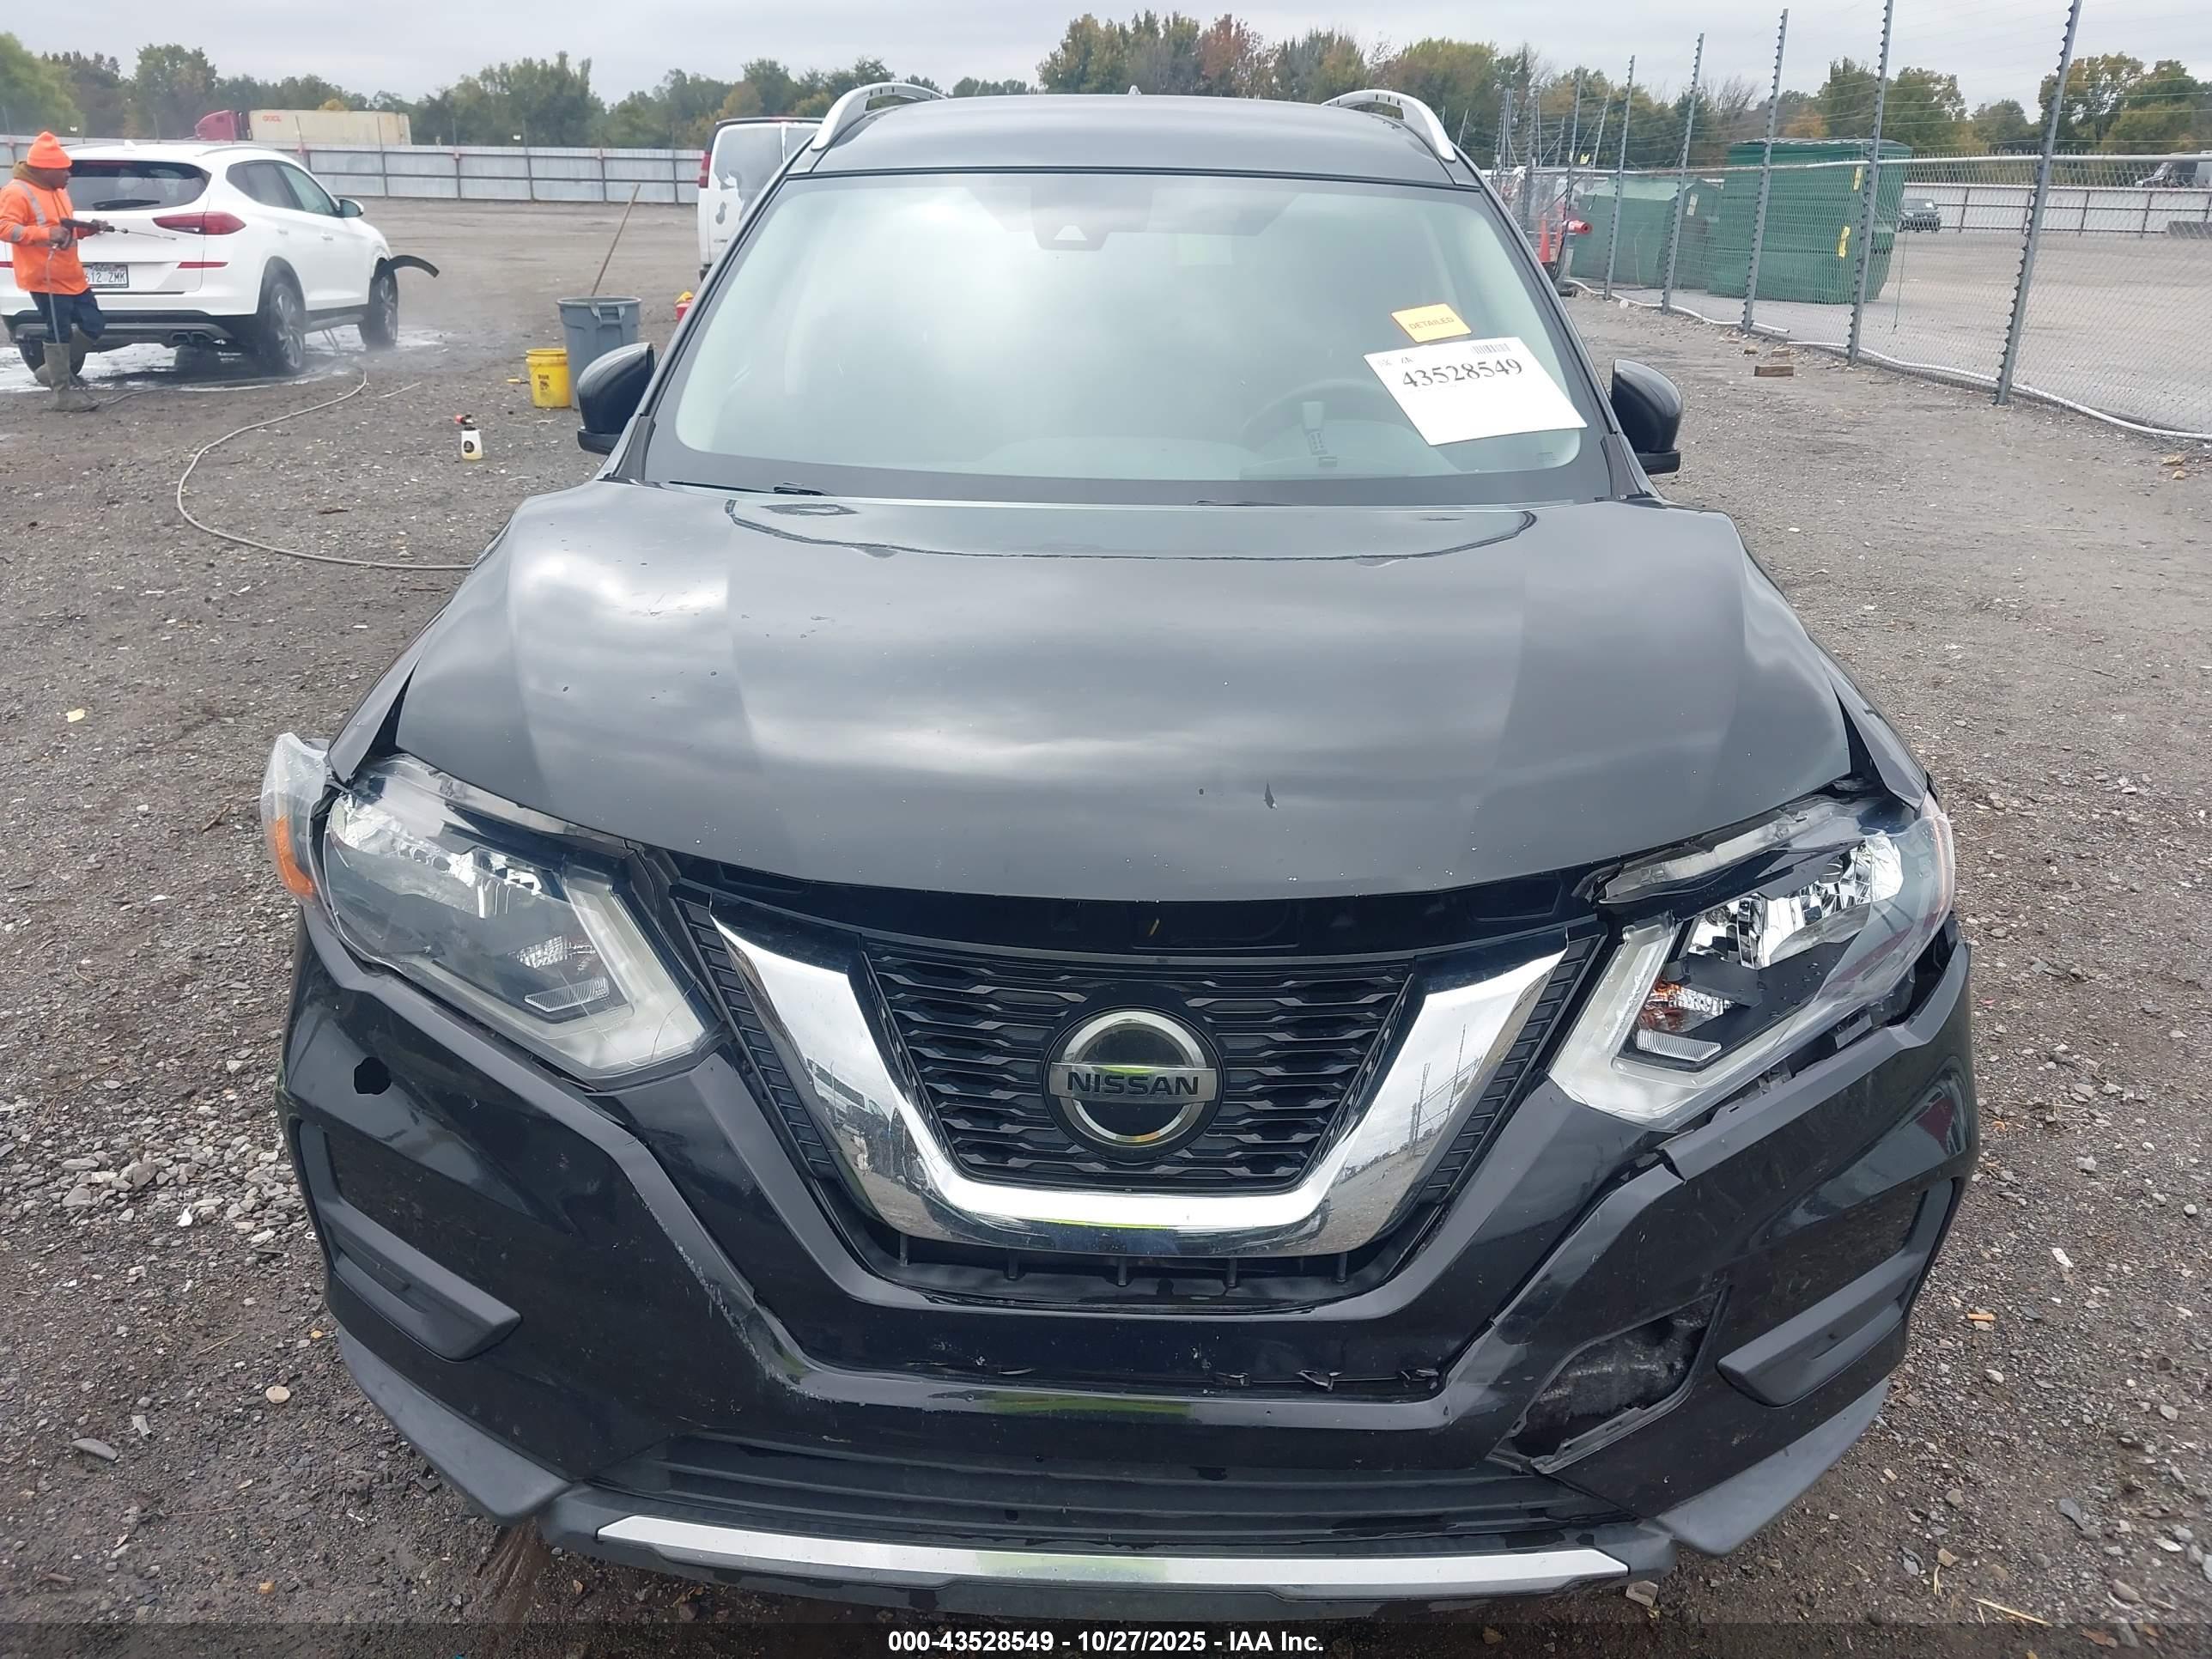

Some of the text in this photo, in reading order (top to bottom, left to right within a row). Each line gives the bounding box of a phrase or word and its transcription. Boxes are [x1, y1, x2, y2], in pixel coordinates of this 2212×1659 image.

[1409, 316, 1455, 330] DETAILED
[1402, 358, 1522, 387] 43528549
[1066, 1071, 1200, 1097] NISSAN
